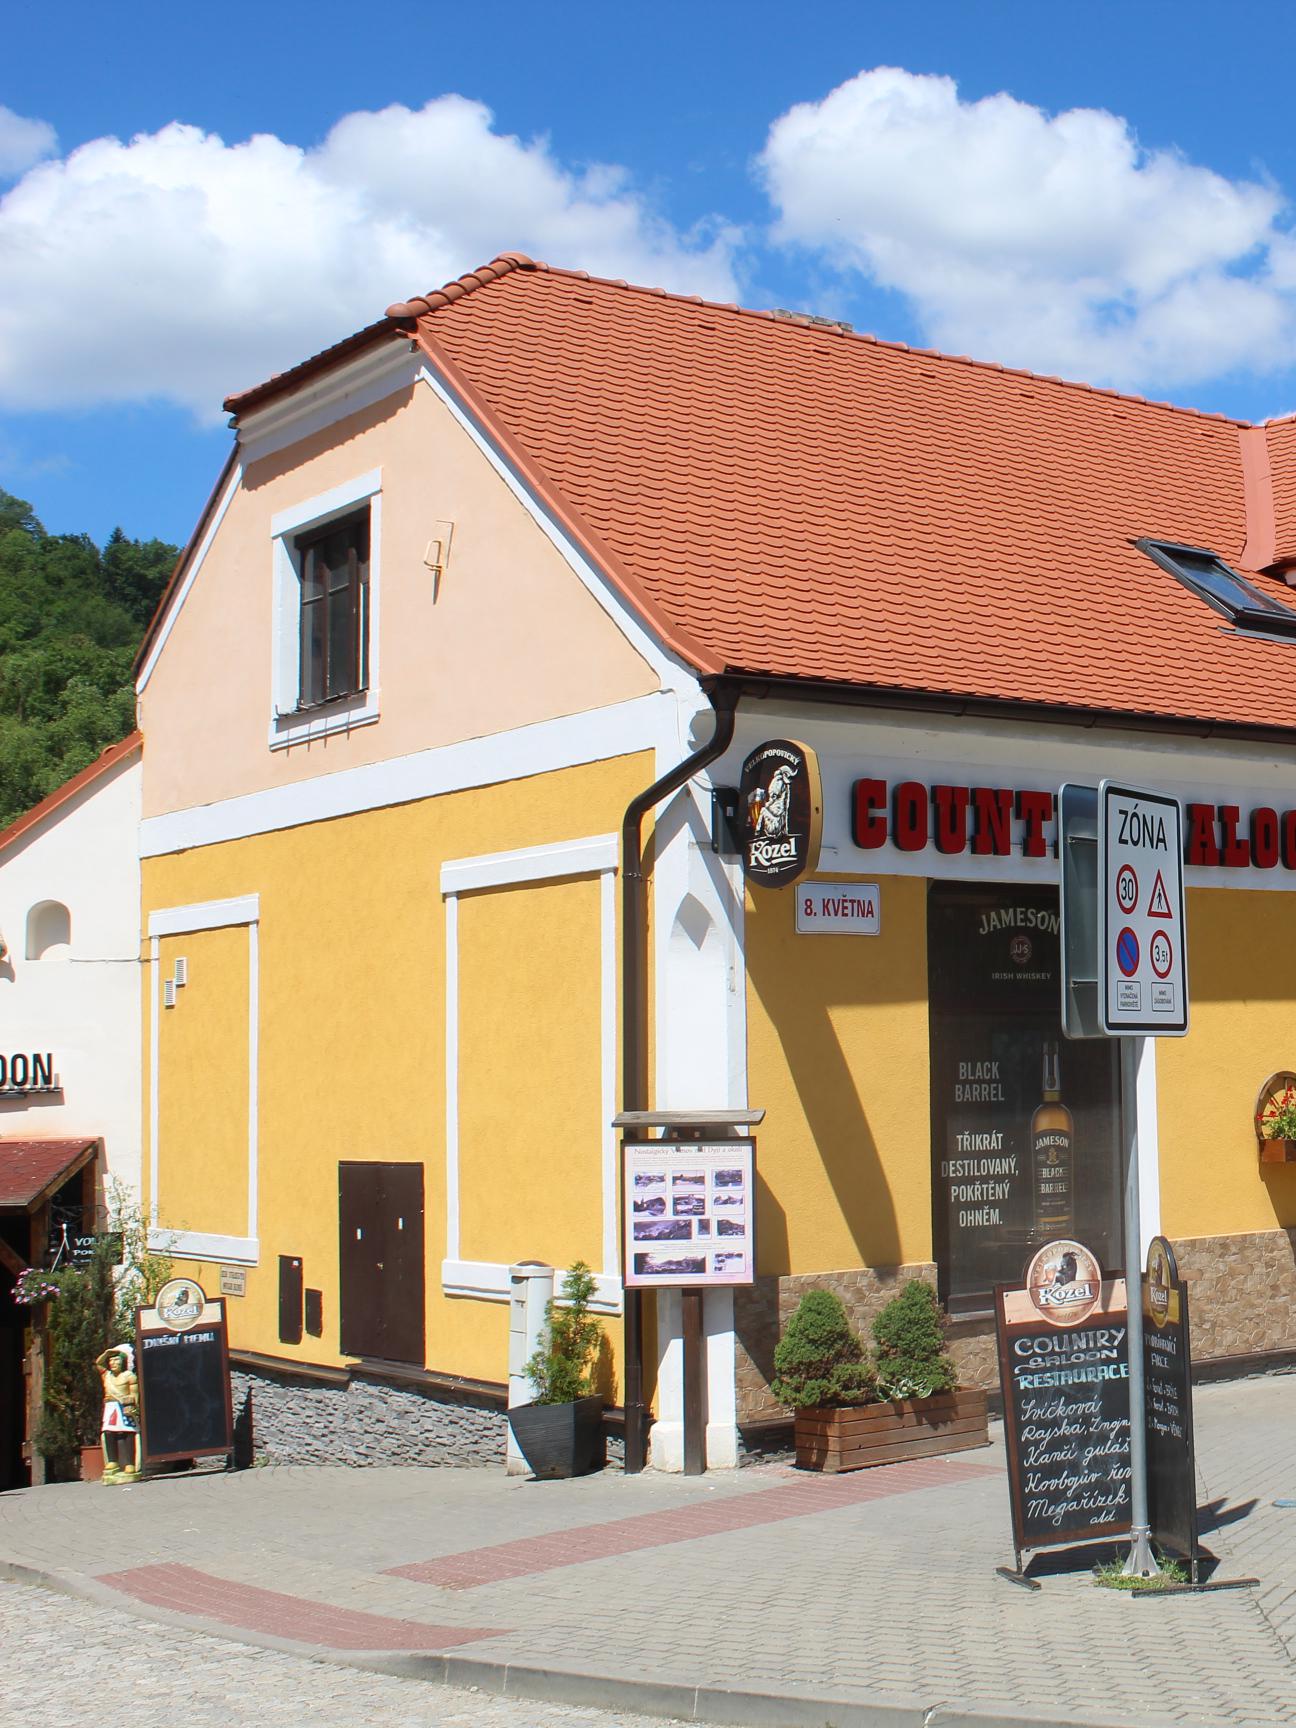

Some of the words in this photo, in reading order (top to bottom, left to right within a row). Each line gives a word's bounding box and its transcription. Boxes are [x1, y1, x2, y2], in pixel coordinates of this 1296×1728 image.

[852, 778, 1060, 859] COUNT
[1118, 803, 1168, 851] ZÓNA
[749, 839, 798, 867] Kozel
[1120, 877, 1134, 901] 30
[804, 899, 817, 917] 8.
[822, 894, 875, 918] KVĚTNA
[979, 908, 1060, 935] JAMESON
[991, 972, 1014, 980] IRISH
[1016, 972, 1052, 980] WHISKEY
[959, 1062, 1000, 1080] BLACK
[955, 1083, 1005, 1102] BARREL
[956, 1130, 1003, 1151] TŘIKRÁT
[1035, 1135, 1069, 1150] JAMESON
[941, 1155, 1019, 1177] DESTILOVANÝ,
[1042, 1168, 1064, 1178] BLACK
[951, 1180, 1010, 1202] POKŘTĚNÝ
[959, 1206, 1003, 1227] OHNĚM.
[1038, 1284, 1093, 1306] Kozel
[1150, 1286, 1168, 1305] Kozel
[164, 1305, 200, 1318] Kozel
[183, 1332, 215, 1344] MENU
[1014, 1328, 1126, 1356] COUNTRY
[1014, 1349, 1118, 1374] SALOON
[1014, 1362, 1130, 1390] RESTAURACE
[1021, 1395, 1102, 1421] Svíčková
[1023, 1443, 1078, 1467] Kančí
[1083, 1437, 1131, 1466] guláš
[1025, 1469, 1103, 1497] Kovbojův
[1027, 1484, 1130, 1526] Megařízek
[1089, 1510, 1115, 1525] atd
